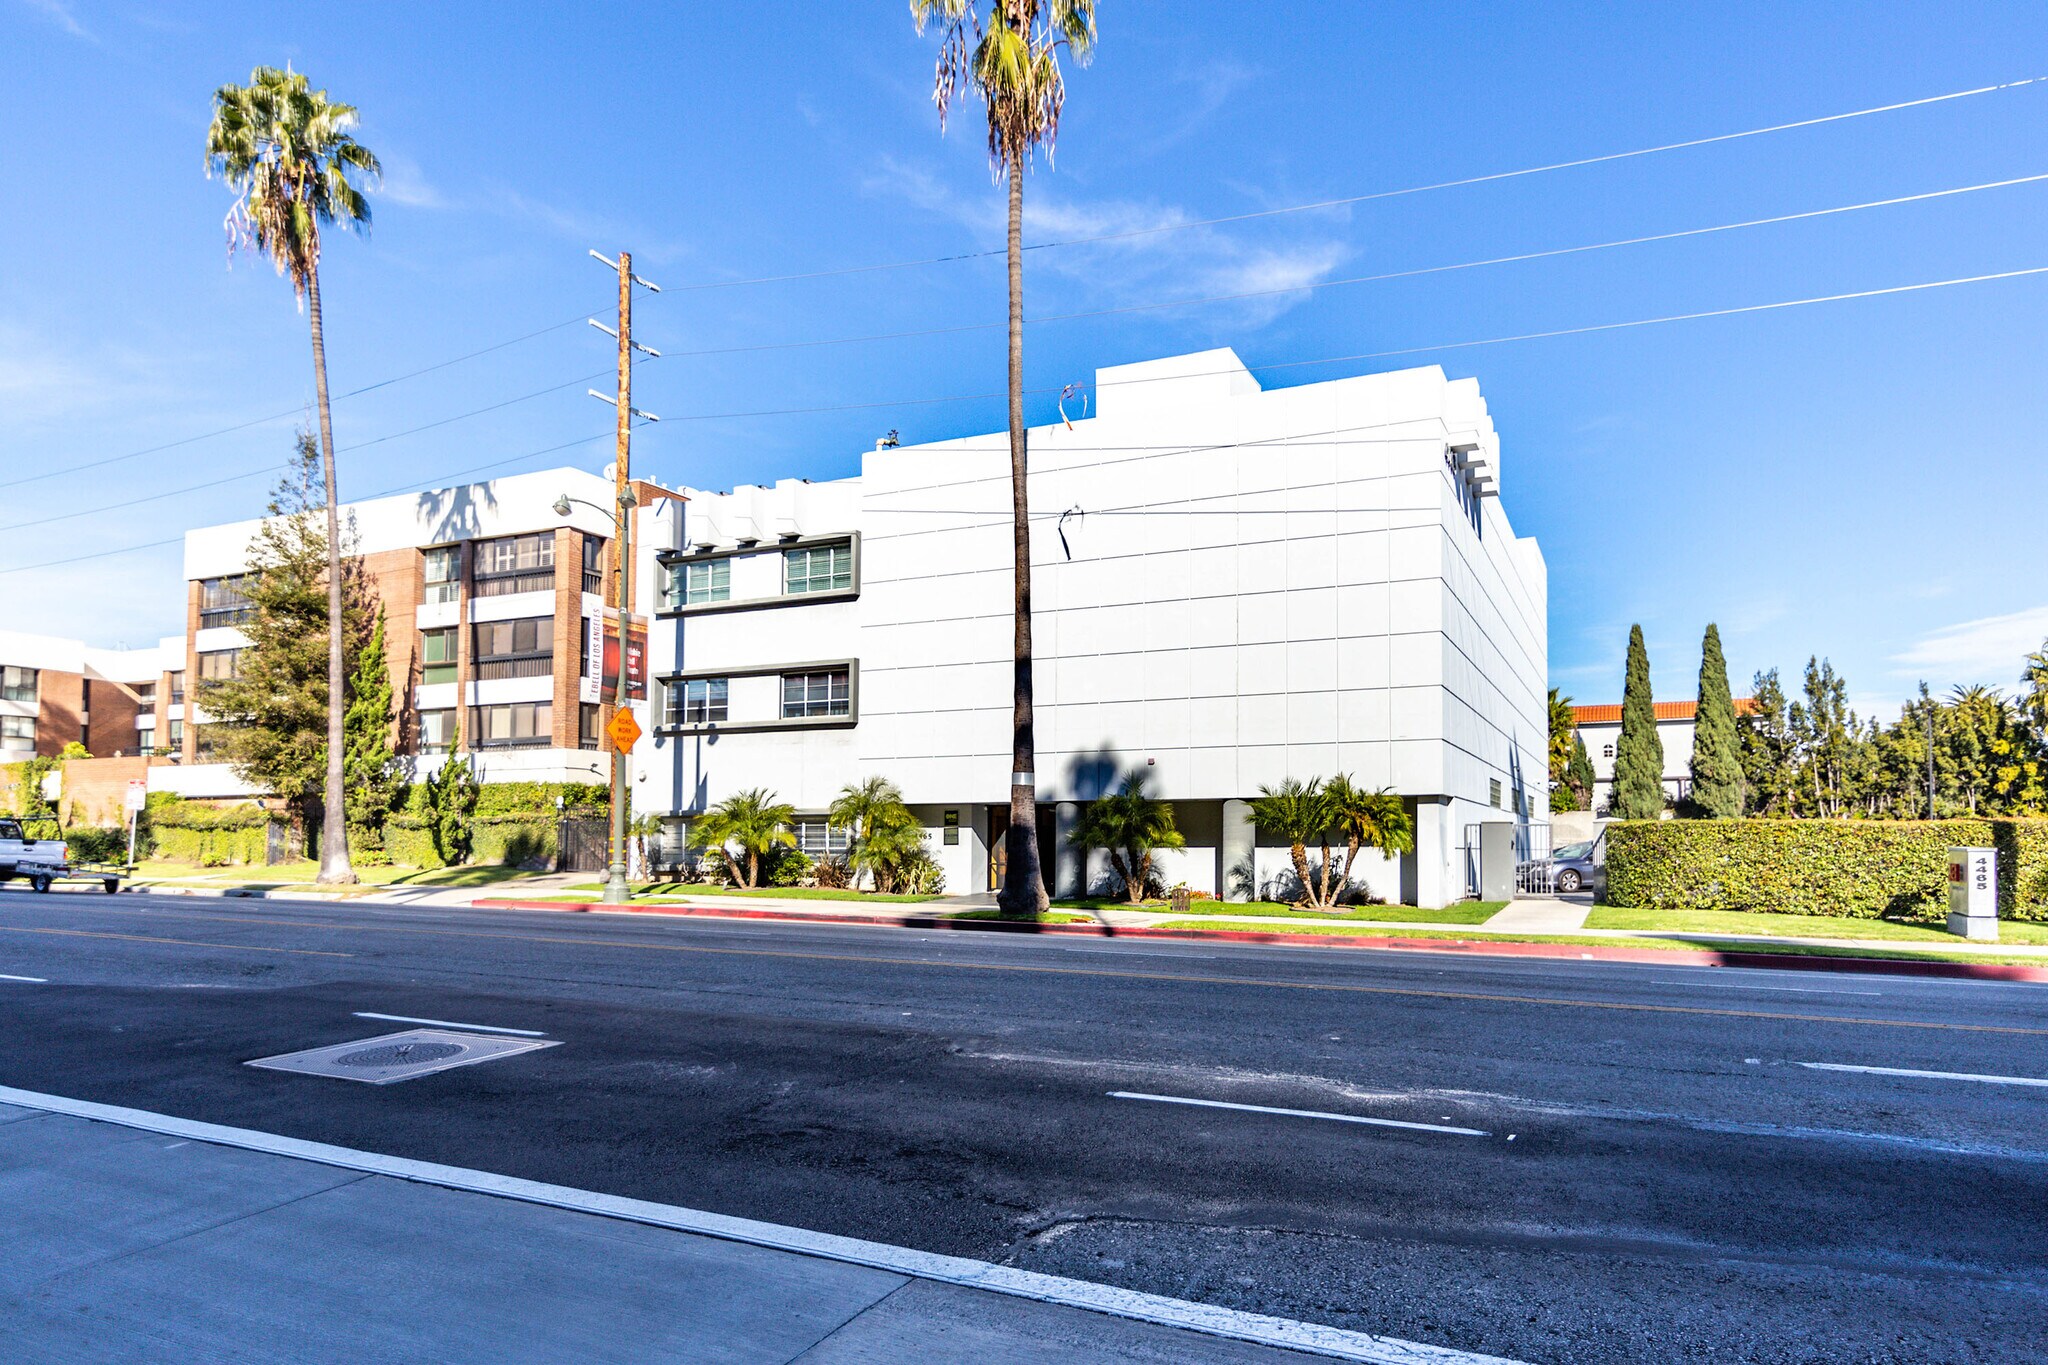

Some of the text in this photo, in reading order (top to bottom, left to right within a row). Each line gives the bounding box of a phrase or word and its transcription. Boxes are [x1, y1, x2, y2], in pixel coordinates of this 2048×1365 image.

[592, 659, 600, 669] OF
[591, 672, 600, 693] EBELL
[1975, 857, 1987, 890] 4465
